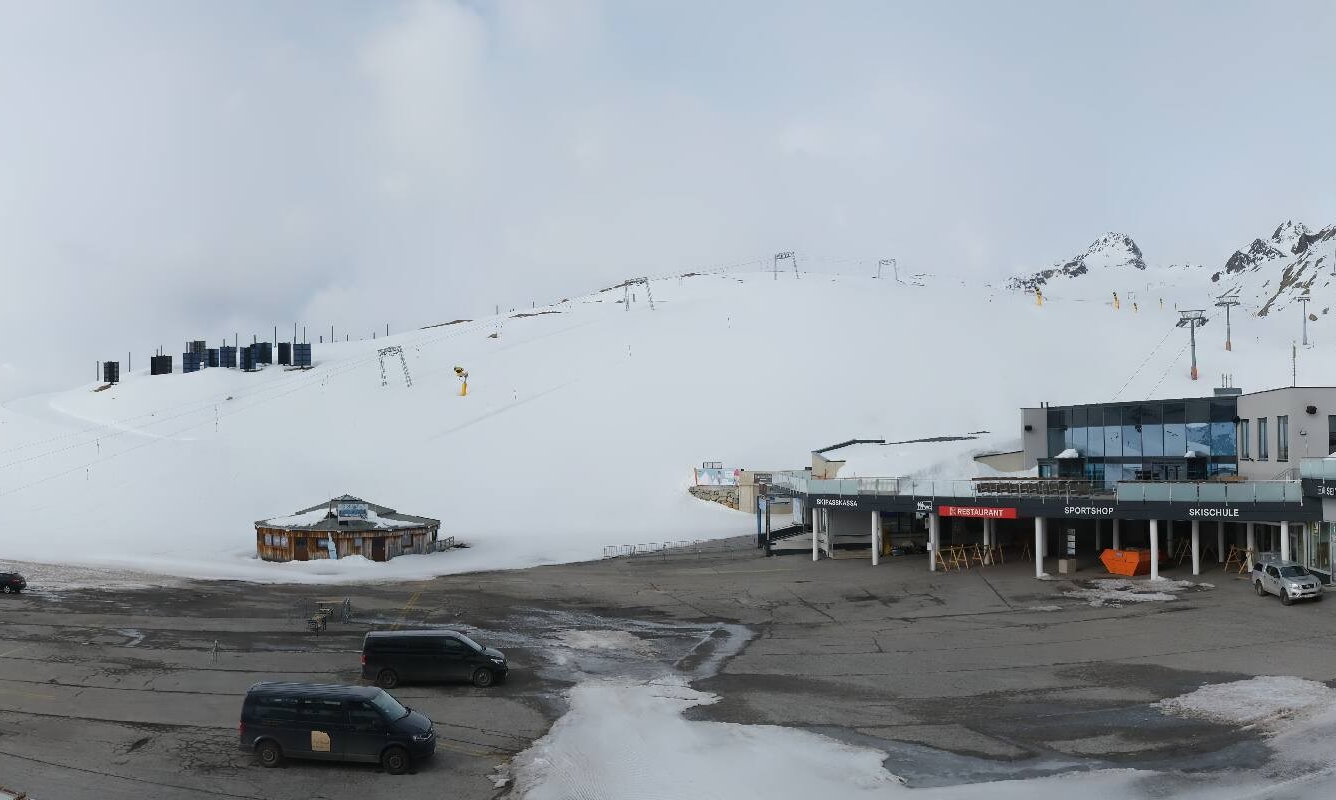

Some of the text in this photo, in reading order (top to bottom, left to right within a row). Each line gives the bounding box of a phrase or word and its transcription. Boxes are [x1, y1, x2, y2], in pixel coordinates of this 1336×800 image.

[957, 507, 1004, 517] RESTAURANT
[1064, 506, 1114, 516] SPORTSHOP
[1189, 508, 1240, 517] SKISCHULE
